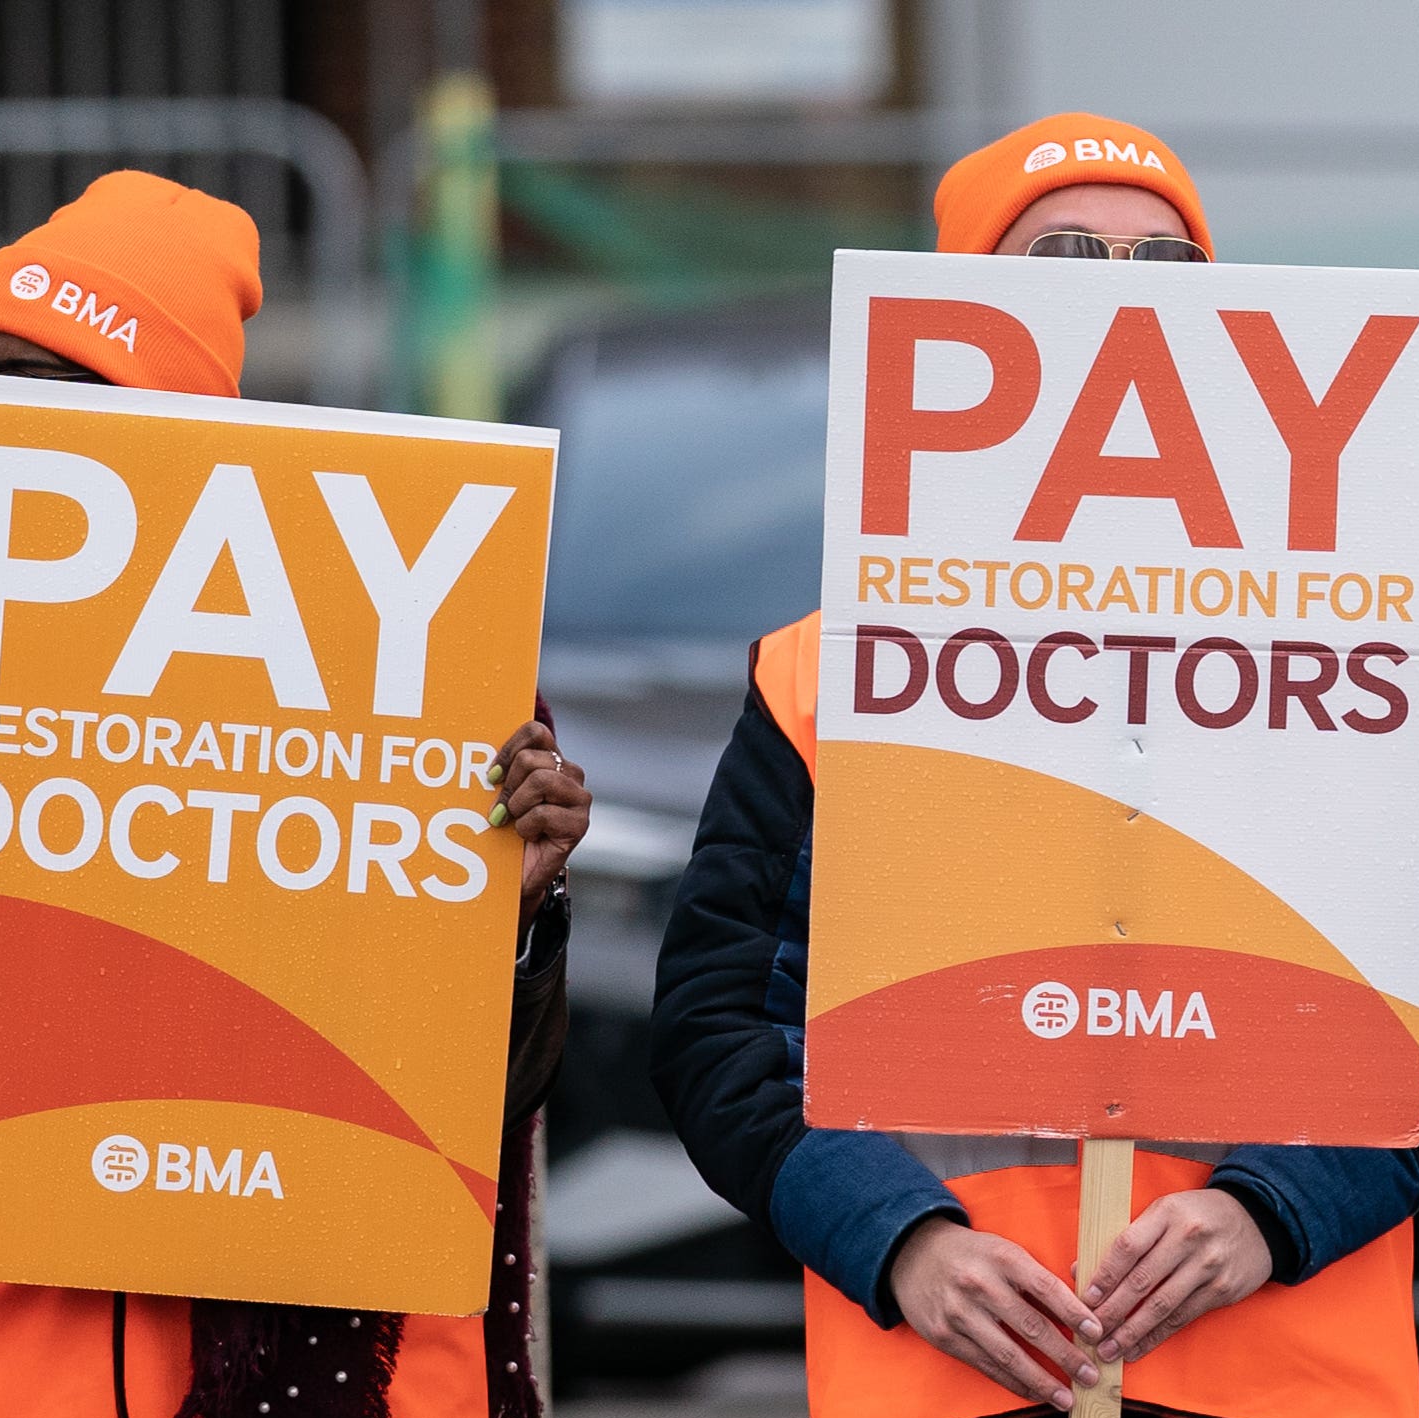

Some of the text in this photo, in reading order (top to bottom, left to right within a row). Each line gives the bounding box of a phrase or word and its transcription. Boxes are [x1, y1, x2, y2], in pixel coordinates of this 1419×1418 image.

[1074, 138, 1166, 174] BMA
[51, 281, 139, 352] BMA
[858, 555, 1414, 622] RESTORATION FOR
[853, 624, 1410, 735] DOCTORS
[378, 735, 496, 791] FOR
[1086, 988, 1216, 1040] BMA
[155, 1142, 285, 1199] BMA
